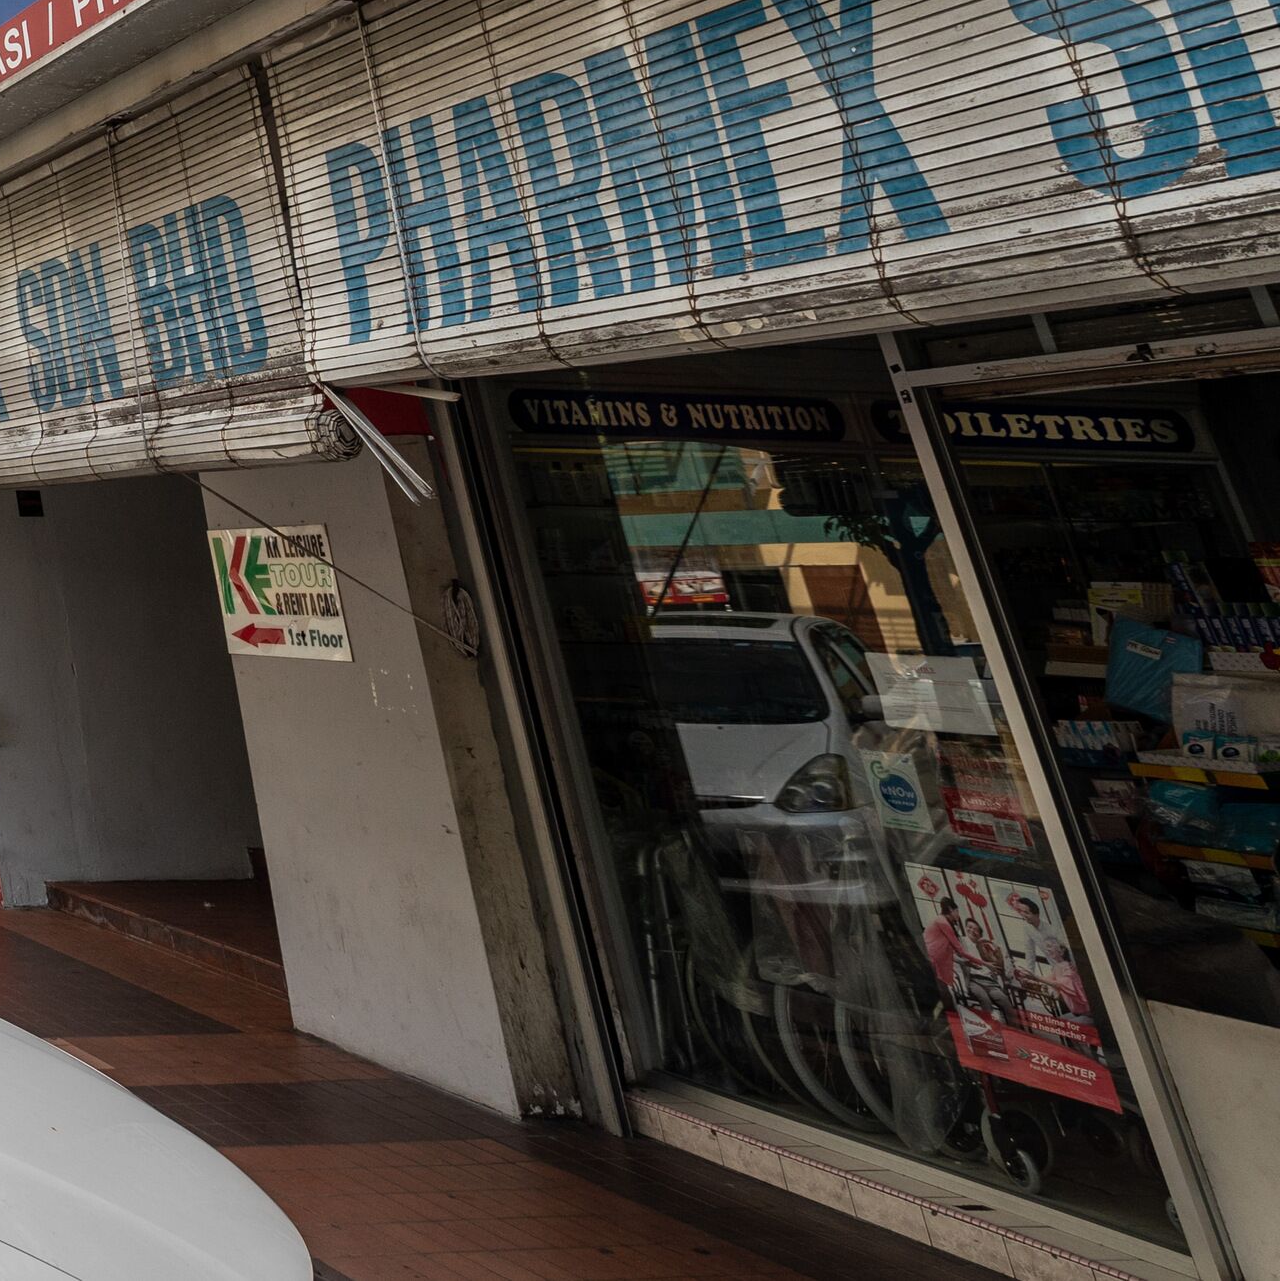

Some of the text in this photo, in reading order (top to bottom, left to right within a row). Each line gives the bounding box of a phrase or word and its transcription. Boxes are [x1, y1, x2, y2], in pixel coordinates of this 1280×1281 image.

[48, 2, 57, 45] /
[17, 243, 123, 412] SDN
[130, 195, 269, 390] BHD
[523, 399, 652, 430] VITAMINS
[685, 403, 832, 434] NUTRITION
[264, 534, 326, 559] KK LEISURE
[270, 563, 333, 587] TOUR
[275, 592, 339, 617] & RENT A CAR
[288, 629, 343, 648] 1st Floor
[1030, 1012, 1081, 1032] No time for
[1039, 1023, 1087, 1042] headache?
